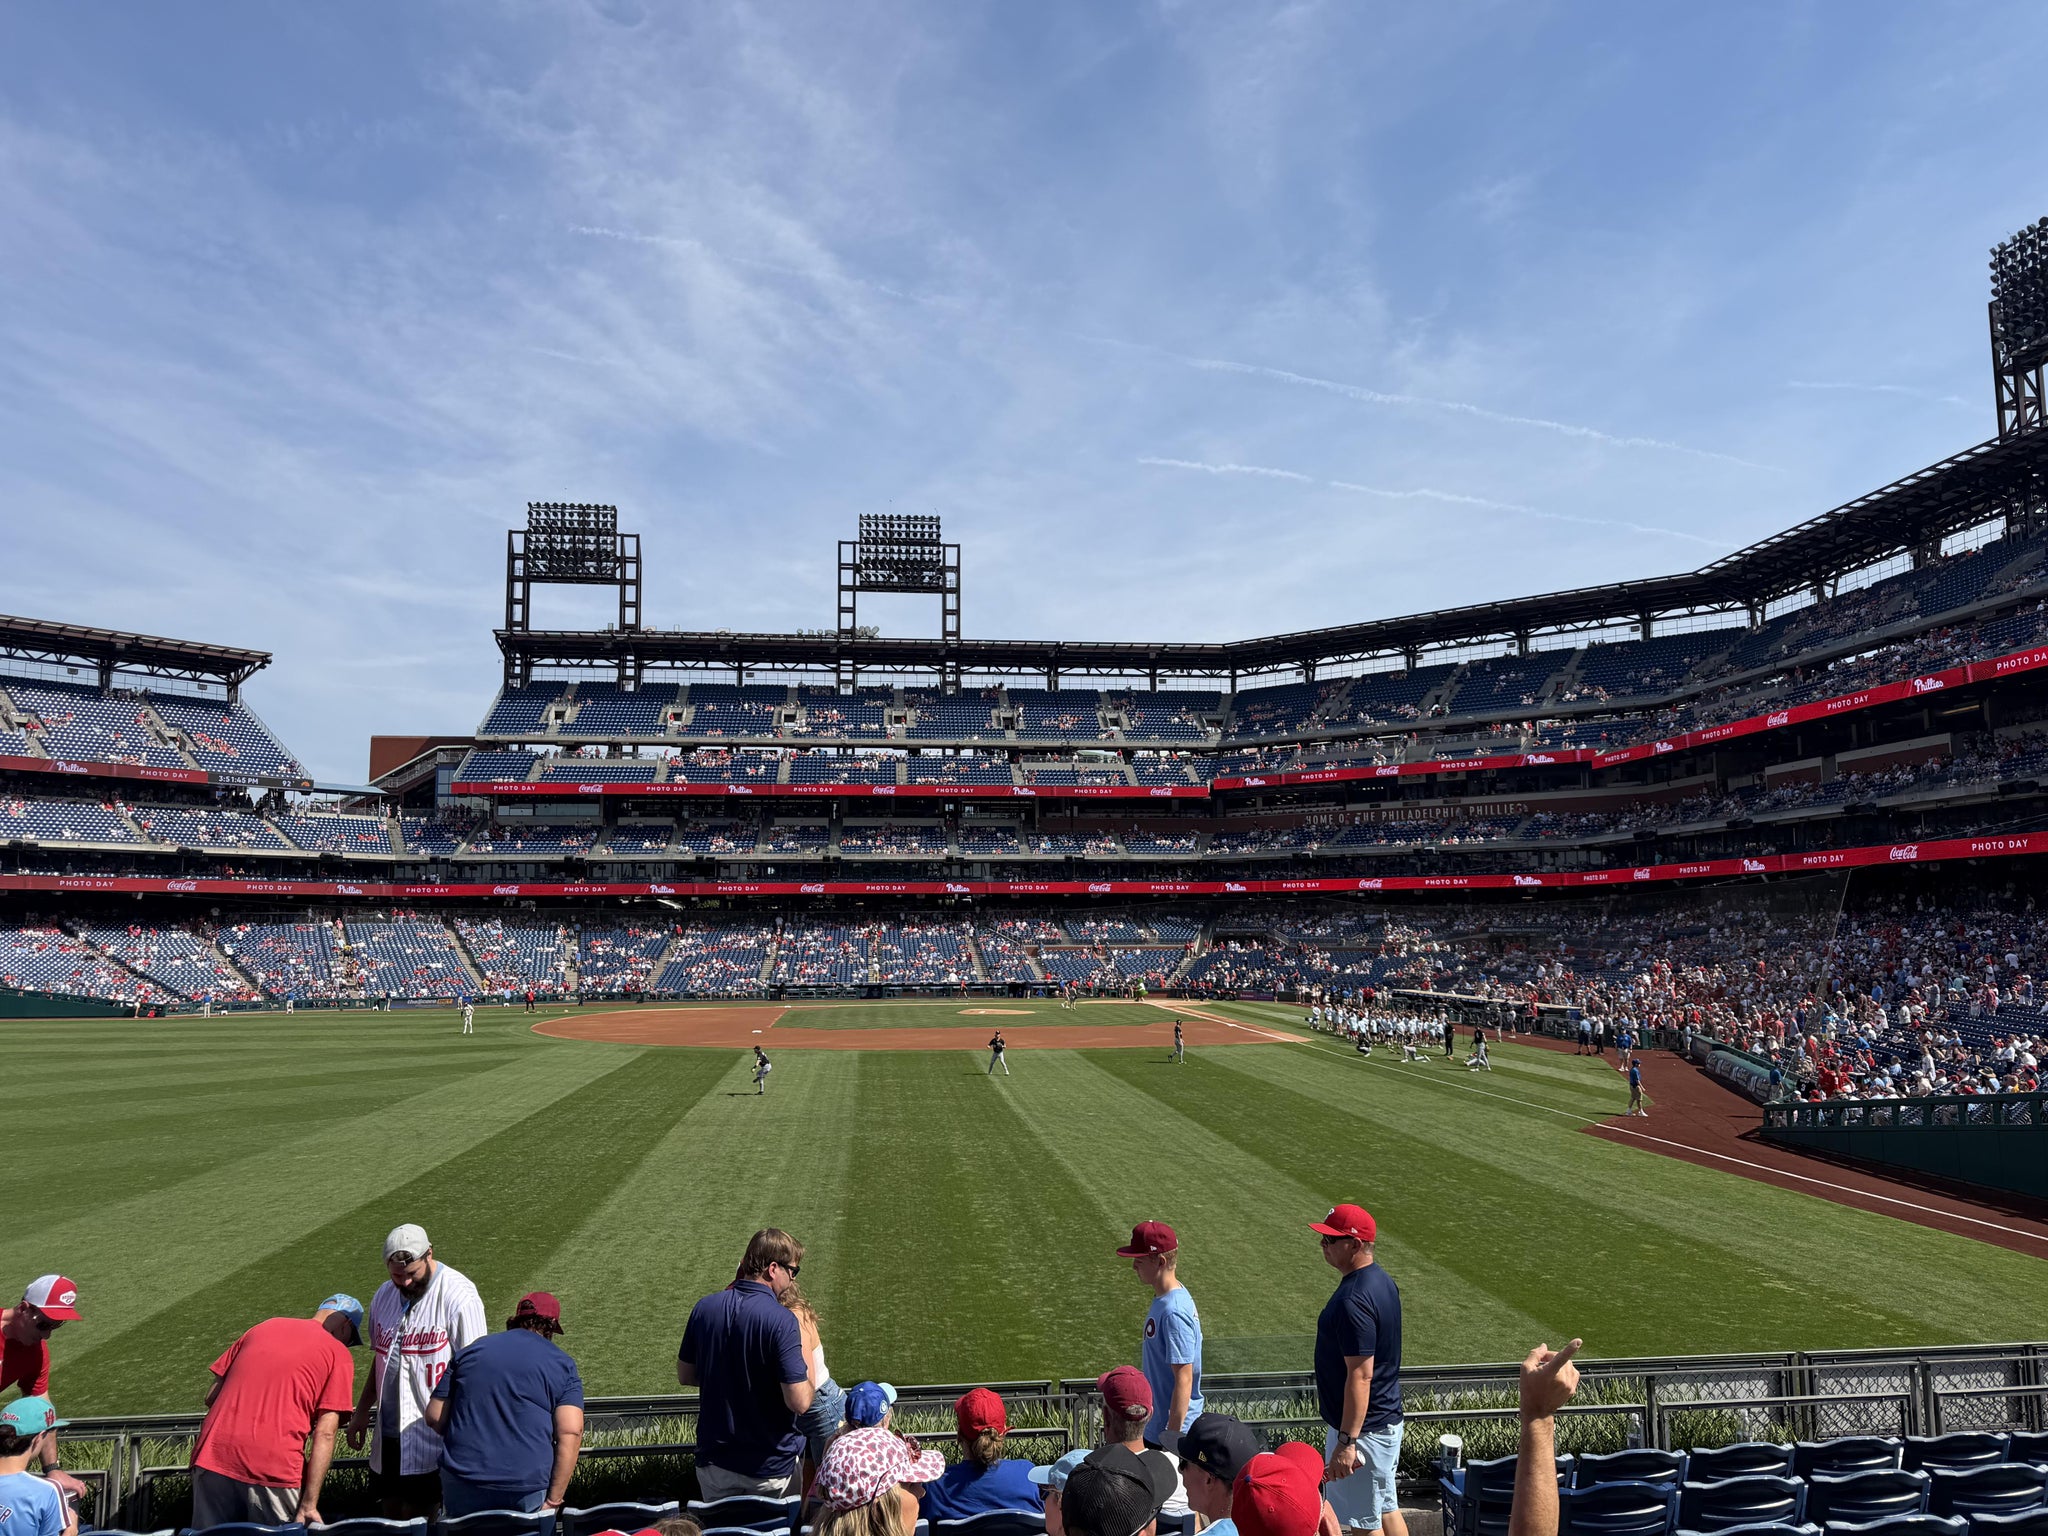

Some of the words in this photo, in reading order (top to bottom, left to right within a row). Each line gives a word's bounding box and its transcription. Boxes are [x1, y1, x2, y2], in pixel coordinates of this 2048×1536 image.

[1996, 656, 2030, 670] PHOTO
[2034, 652, 2048, 662] DA
[1914, 678, 1944, 692] Phillies
[1828, 699, 1851, 711] PHOTO
[1854, 695, 1869, 705] DAY
[1702, 731, 1722, 740] PHOTO
[1724, 727, 1733, 736] DAY
[1656, 742, 1673, 752] Phillies
[1527, 752, 1555, 764] Phillies
[1604, 755, 1620, 763] PHOTO
[1621, 752, 1630, 760] DAY
[57, 762, 88, 773] Phillies
[141, 769, 169, 778] PHOTO
[1324, 771, 1338, 779] DAY
[218, 775, 246, 785] 3:51:45
[247, 776, 259, 785] PM
[1245, 777, 1265, 786] Phillies
[728, 784, 752, 795] Phillies
[1013, 786, 1036, 796] Phillies
[1306, 813, 1333, 825] HOME
[1382, 806, 1458, 821] PHILADELPHI
[1972, 841, 2005, 851] PHOTO
[2009, 839, 2028, 849] DAY
[1744, 859, 1765, 870] Phillies
[1804, 855, 1828, 864] PHOTO
[1830, 854, 1844, 863] DAY
[1680, 866, 1698, 874] PHOTO
[1700, 865, 1711, 873] DAY
[1514, 875, 1542, 886] Phillies
[337, 884, 362, 895] Phillies
[650, 884, 675, 894] Phillies
[946, 884, 970, 893] Phillies
[1225, 883, 1246, 892] Phillies
